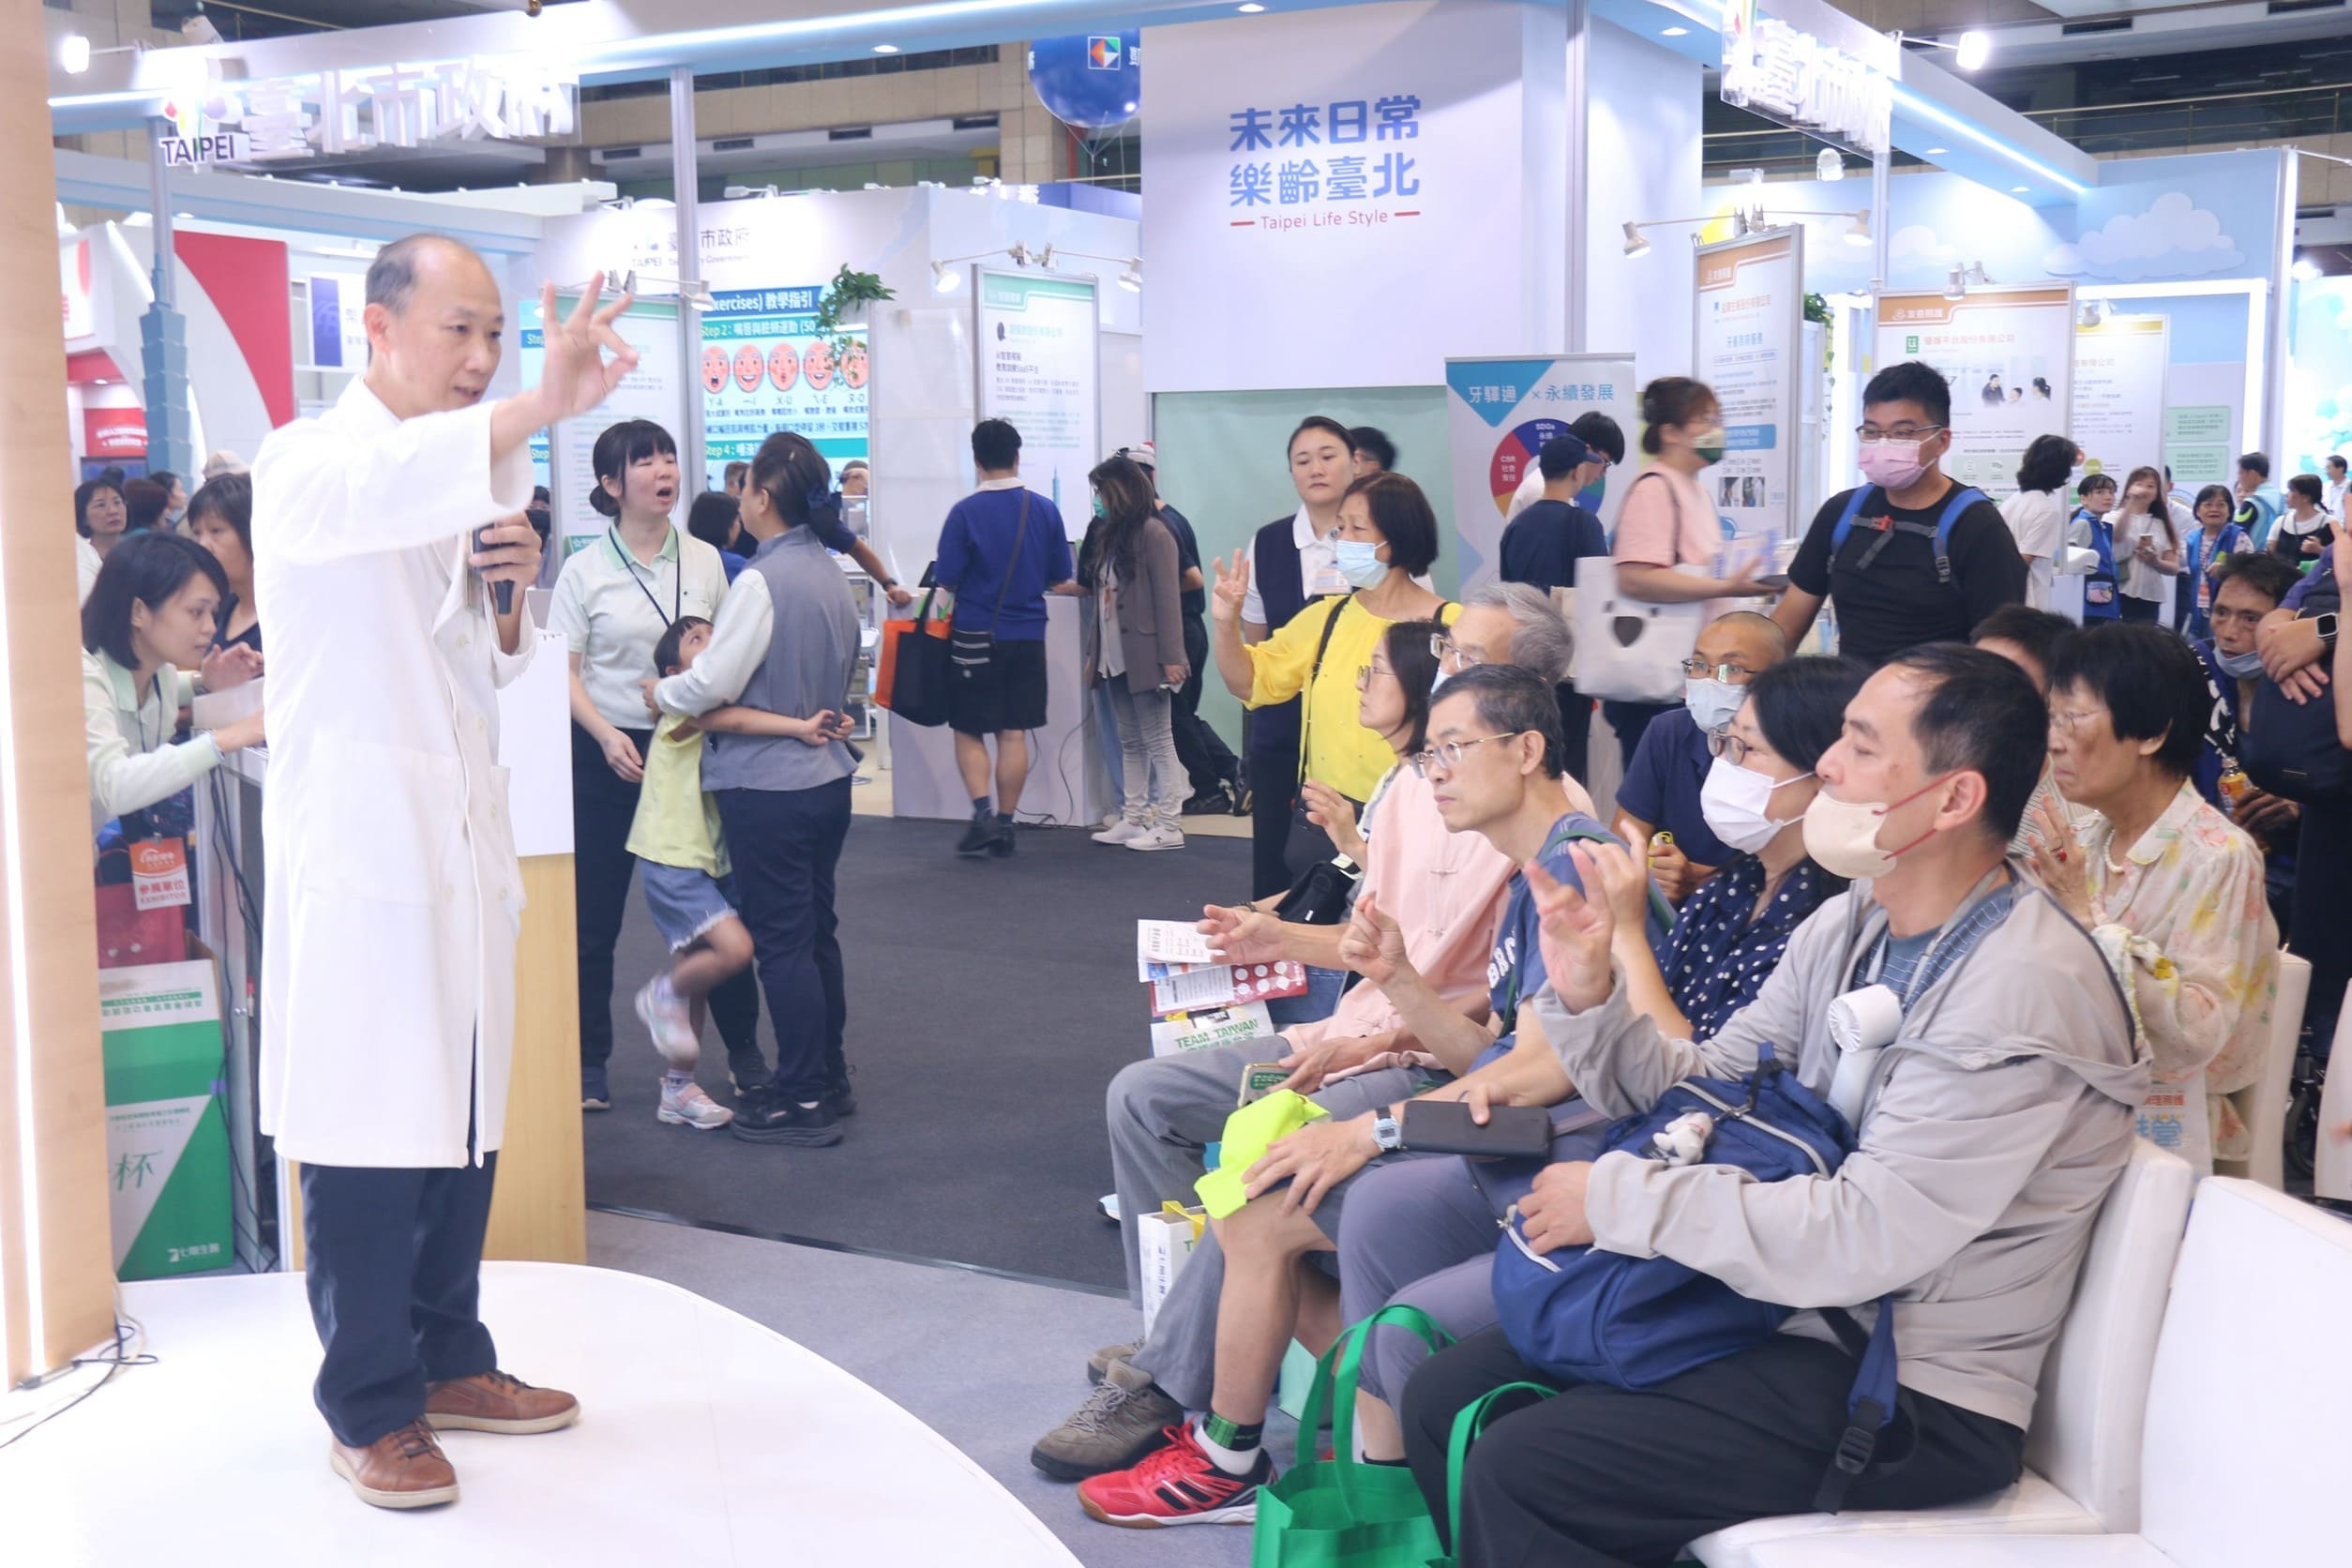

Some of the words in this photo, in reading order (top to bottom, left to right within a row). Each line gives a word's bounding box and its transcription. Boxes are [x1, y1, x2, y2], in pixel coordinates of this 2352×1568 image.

[1229, 95, 1421, 151] 未來日常
[161, 134, 235, 165] TAIPEI
[1229, 152, 1420, 207] 樂齡臺北
[1260, 214, 1306, 232] Taipei
[1313, 212, 1342, 227] Life
[1349, 209, 1388, 227] Style
[713, 295, 762, 312] xercises)
[765, 291, 813, 309] 教學指引
[1546, 384, 1615, 401] 永續發展
[1176, 1033, 1210, 1049] TEAM
[1214, 1018, 1259, 1041] TAIWAN
[114, 1151, 162, 1191] 杯
